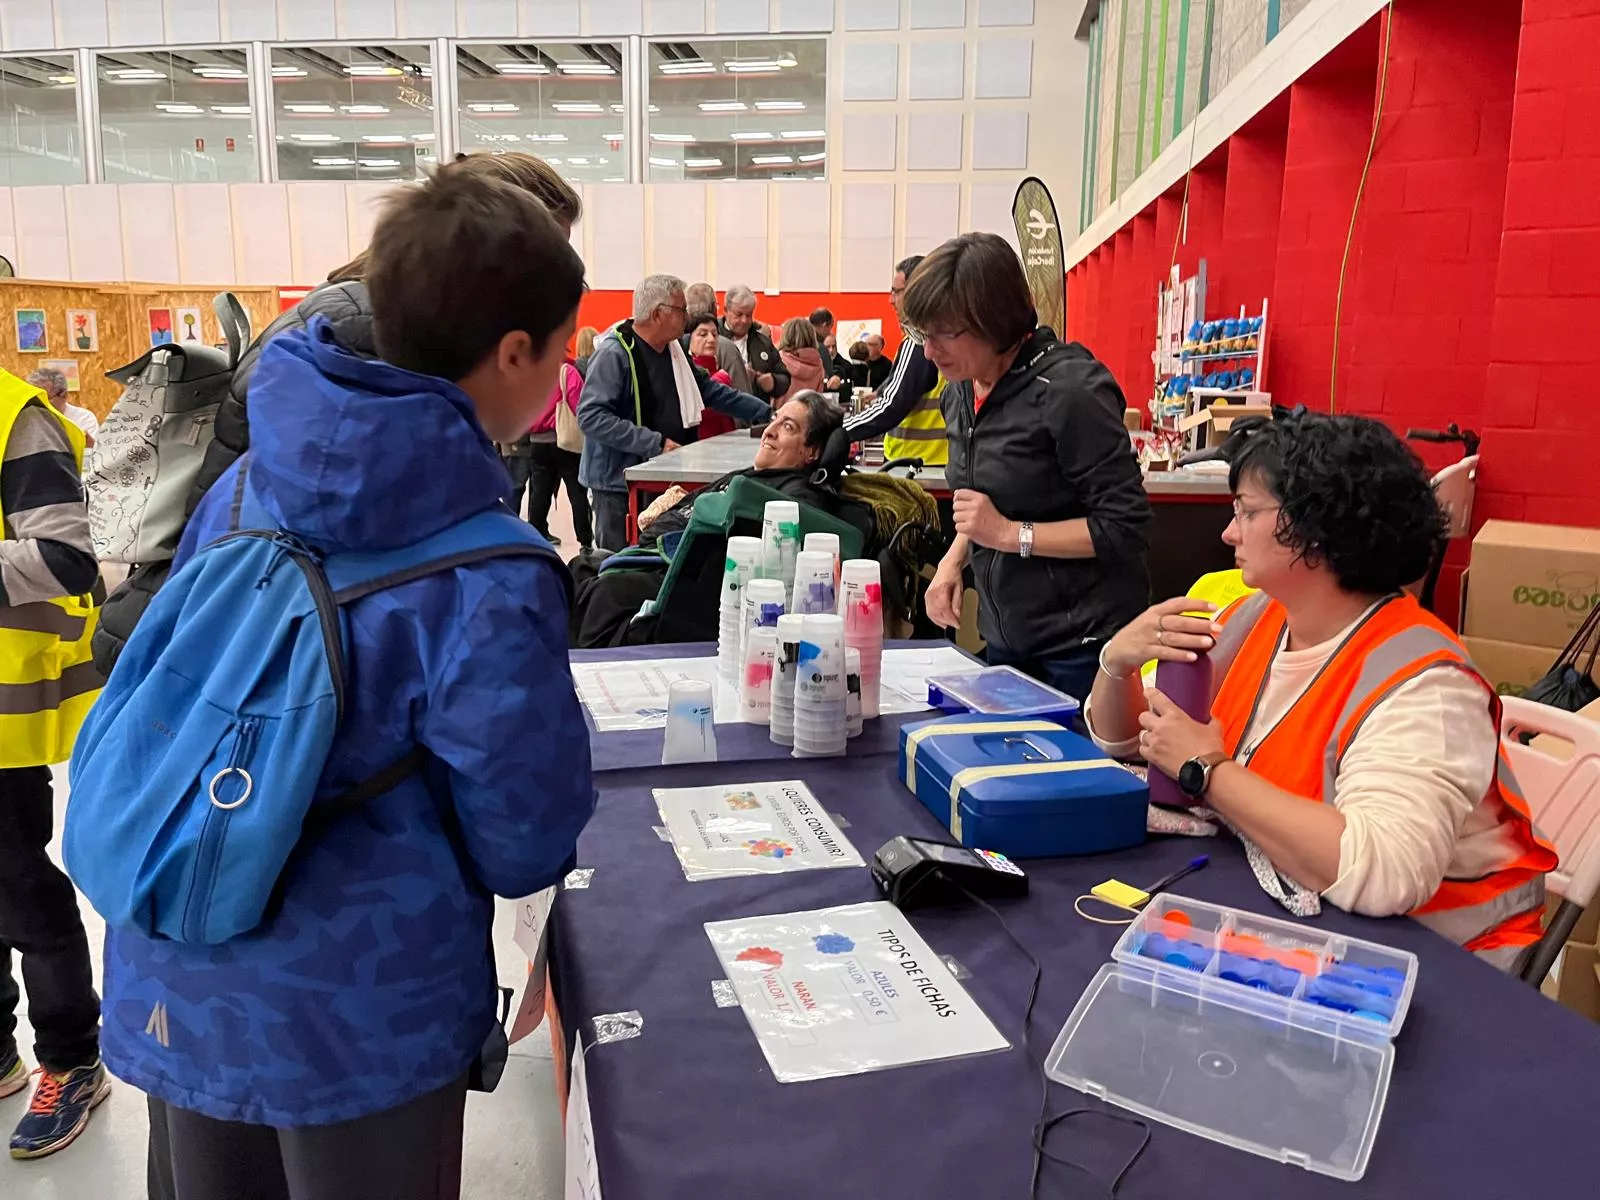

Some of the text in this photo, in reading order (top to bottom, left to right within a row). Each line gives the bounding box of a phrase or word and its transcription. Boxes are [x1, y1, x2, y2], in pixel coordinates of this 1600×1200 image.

[781, 787, 844, 857] ¿QUIERES CONSUMIR?
[843, 960, 866, 984] VALOR
[870, 970, 899, 998] AZULES
[877, 929, 911, 958] TIPOS
[899, 960, 920, 976] DE
[912, 977, 956, 1018] FICHAS
[761, 975, 785, 999] VALOR
